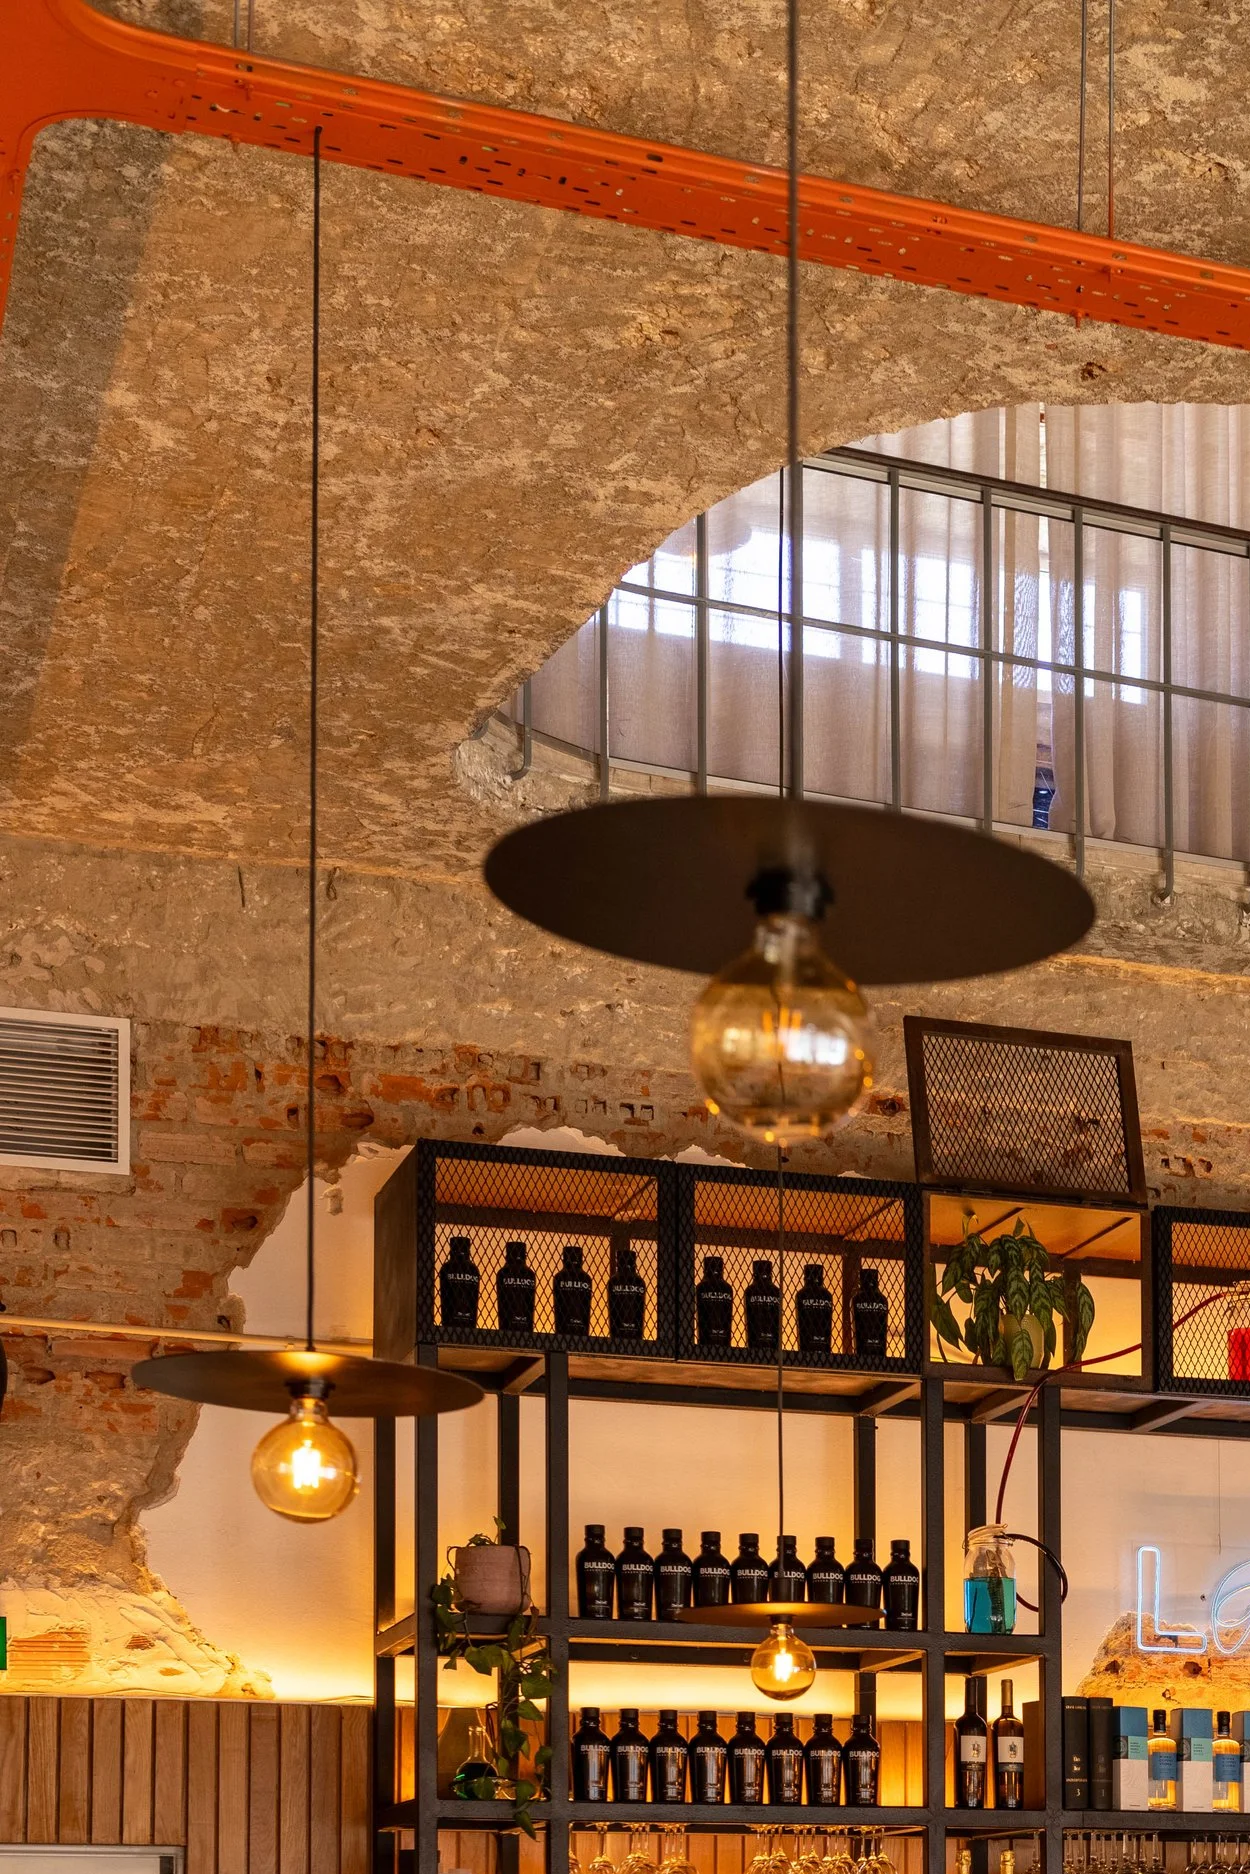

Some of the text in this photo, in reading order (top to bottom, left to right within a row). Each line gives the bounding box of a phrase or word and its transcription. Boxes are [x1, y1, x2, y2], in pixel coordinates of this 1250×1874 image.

[584, 1562, 614, 1570] BULLDOG
[622, 1564, 653, 1572] BULLDOG
[660, 1565, 691, 1574] BULLDOG
[700, 1567, 730, 1576] BULLDOG
[738, 1569, 768, 1577] BULLDOG
[774, 1571, 805, 1579] BLLDOG
[850, 1574, 881, 1582] BULLDOG
[890, 1576, 919, 1584] BULLDOG
[581, 1744, 610, 1752] BULLDOG
[618, 1745, 648, 1753] BULLDOG
[657, 1746, 688, 1754] BULLDOG
[734, 1748, 764, 1756] BULLDOG
[772, 1749, 802, 1757] BULLDOG
[810, 1750, 840, 1758] BULLDOG
[850, 1751, 880, 1759] BULLDOG
